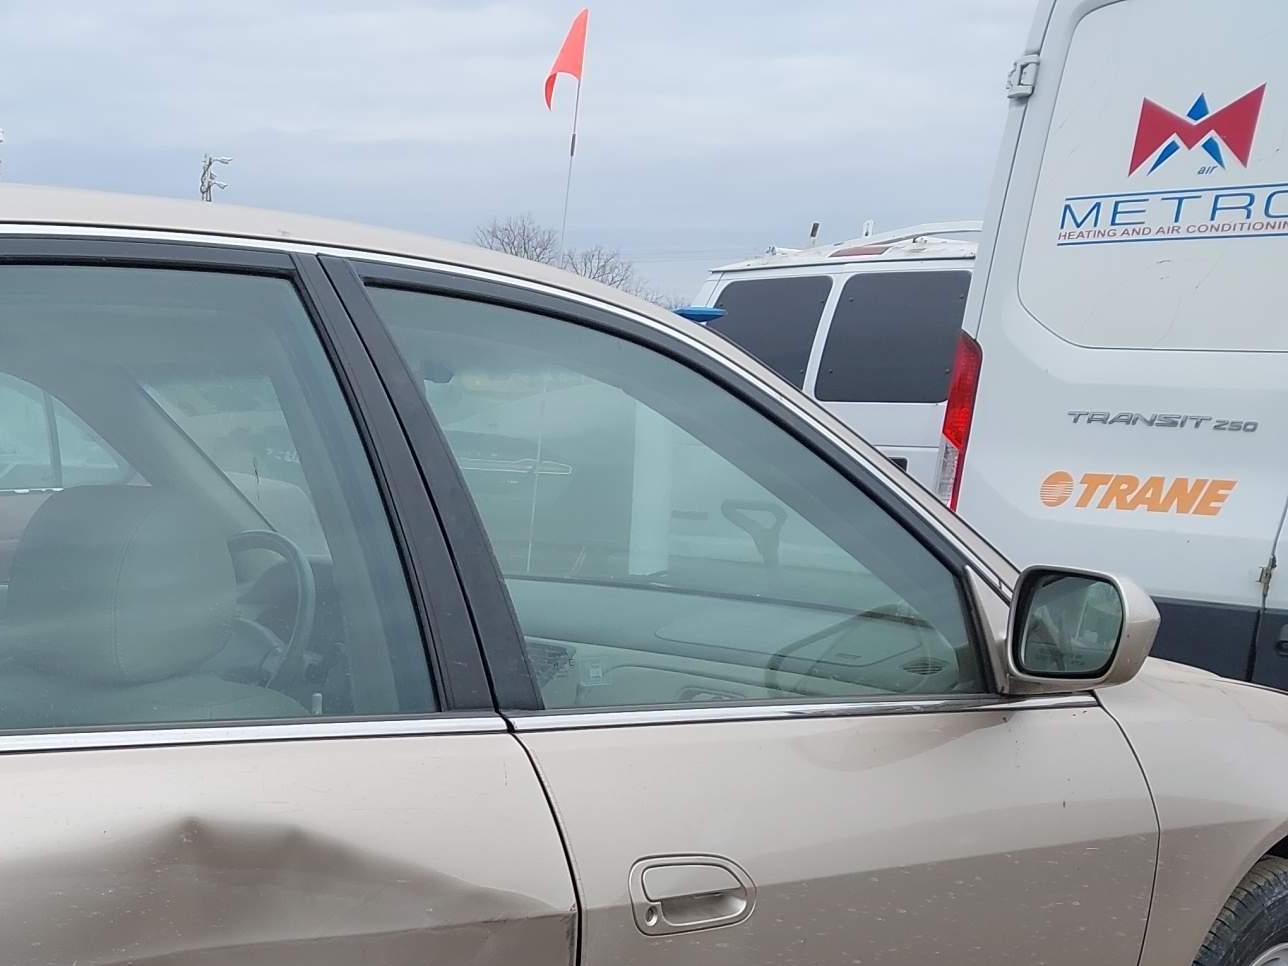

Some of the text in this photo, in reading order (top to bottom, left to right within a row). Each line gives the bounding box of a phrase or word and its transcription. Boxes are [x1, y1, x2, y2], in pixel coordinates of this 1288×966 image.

[1197, 165, 1218, 175] air
[1058, 228, 1117, 240] HEATING
[1120, 226, 1151, 237] AND
[1155, 224, 1181, 235] AIR
[1067, 410, 1259, 433] TRANSIT 250
[1075, 472, 1238, 516] TRANE
